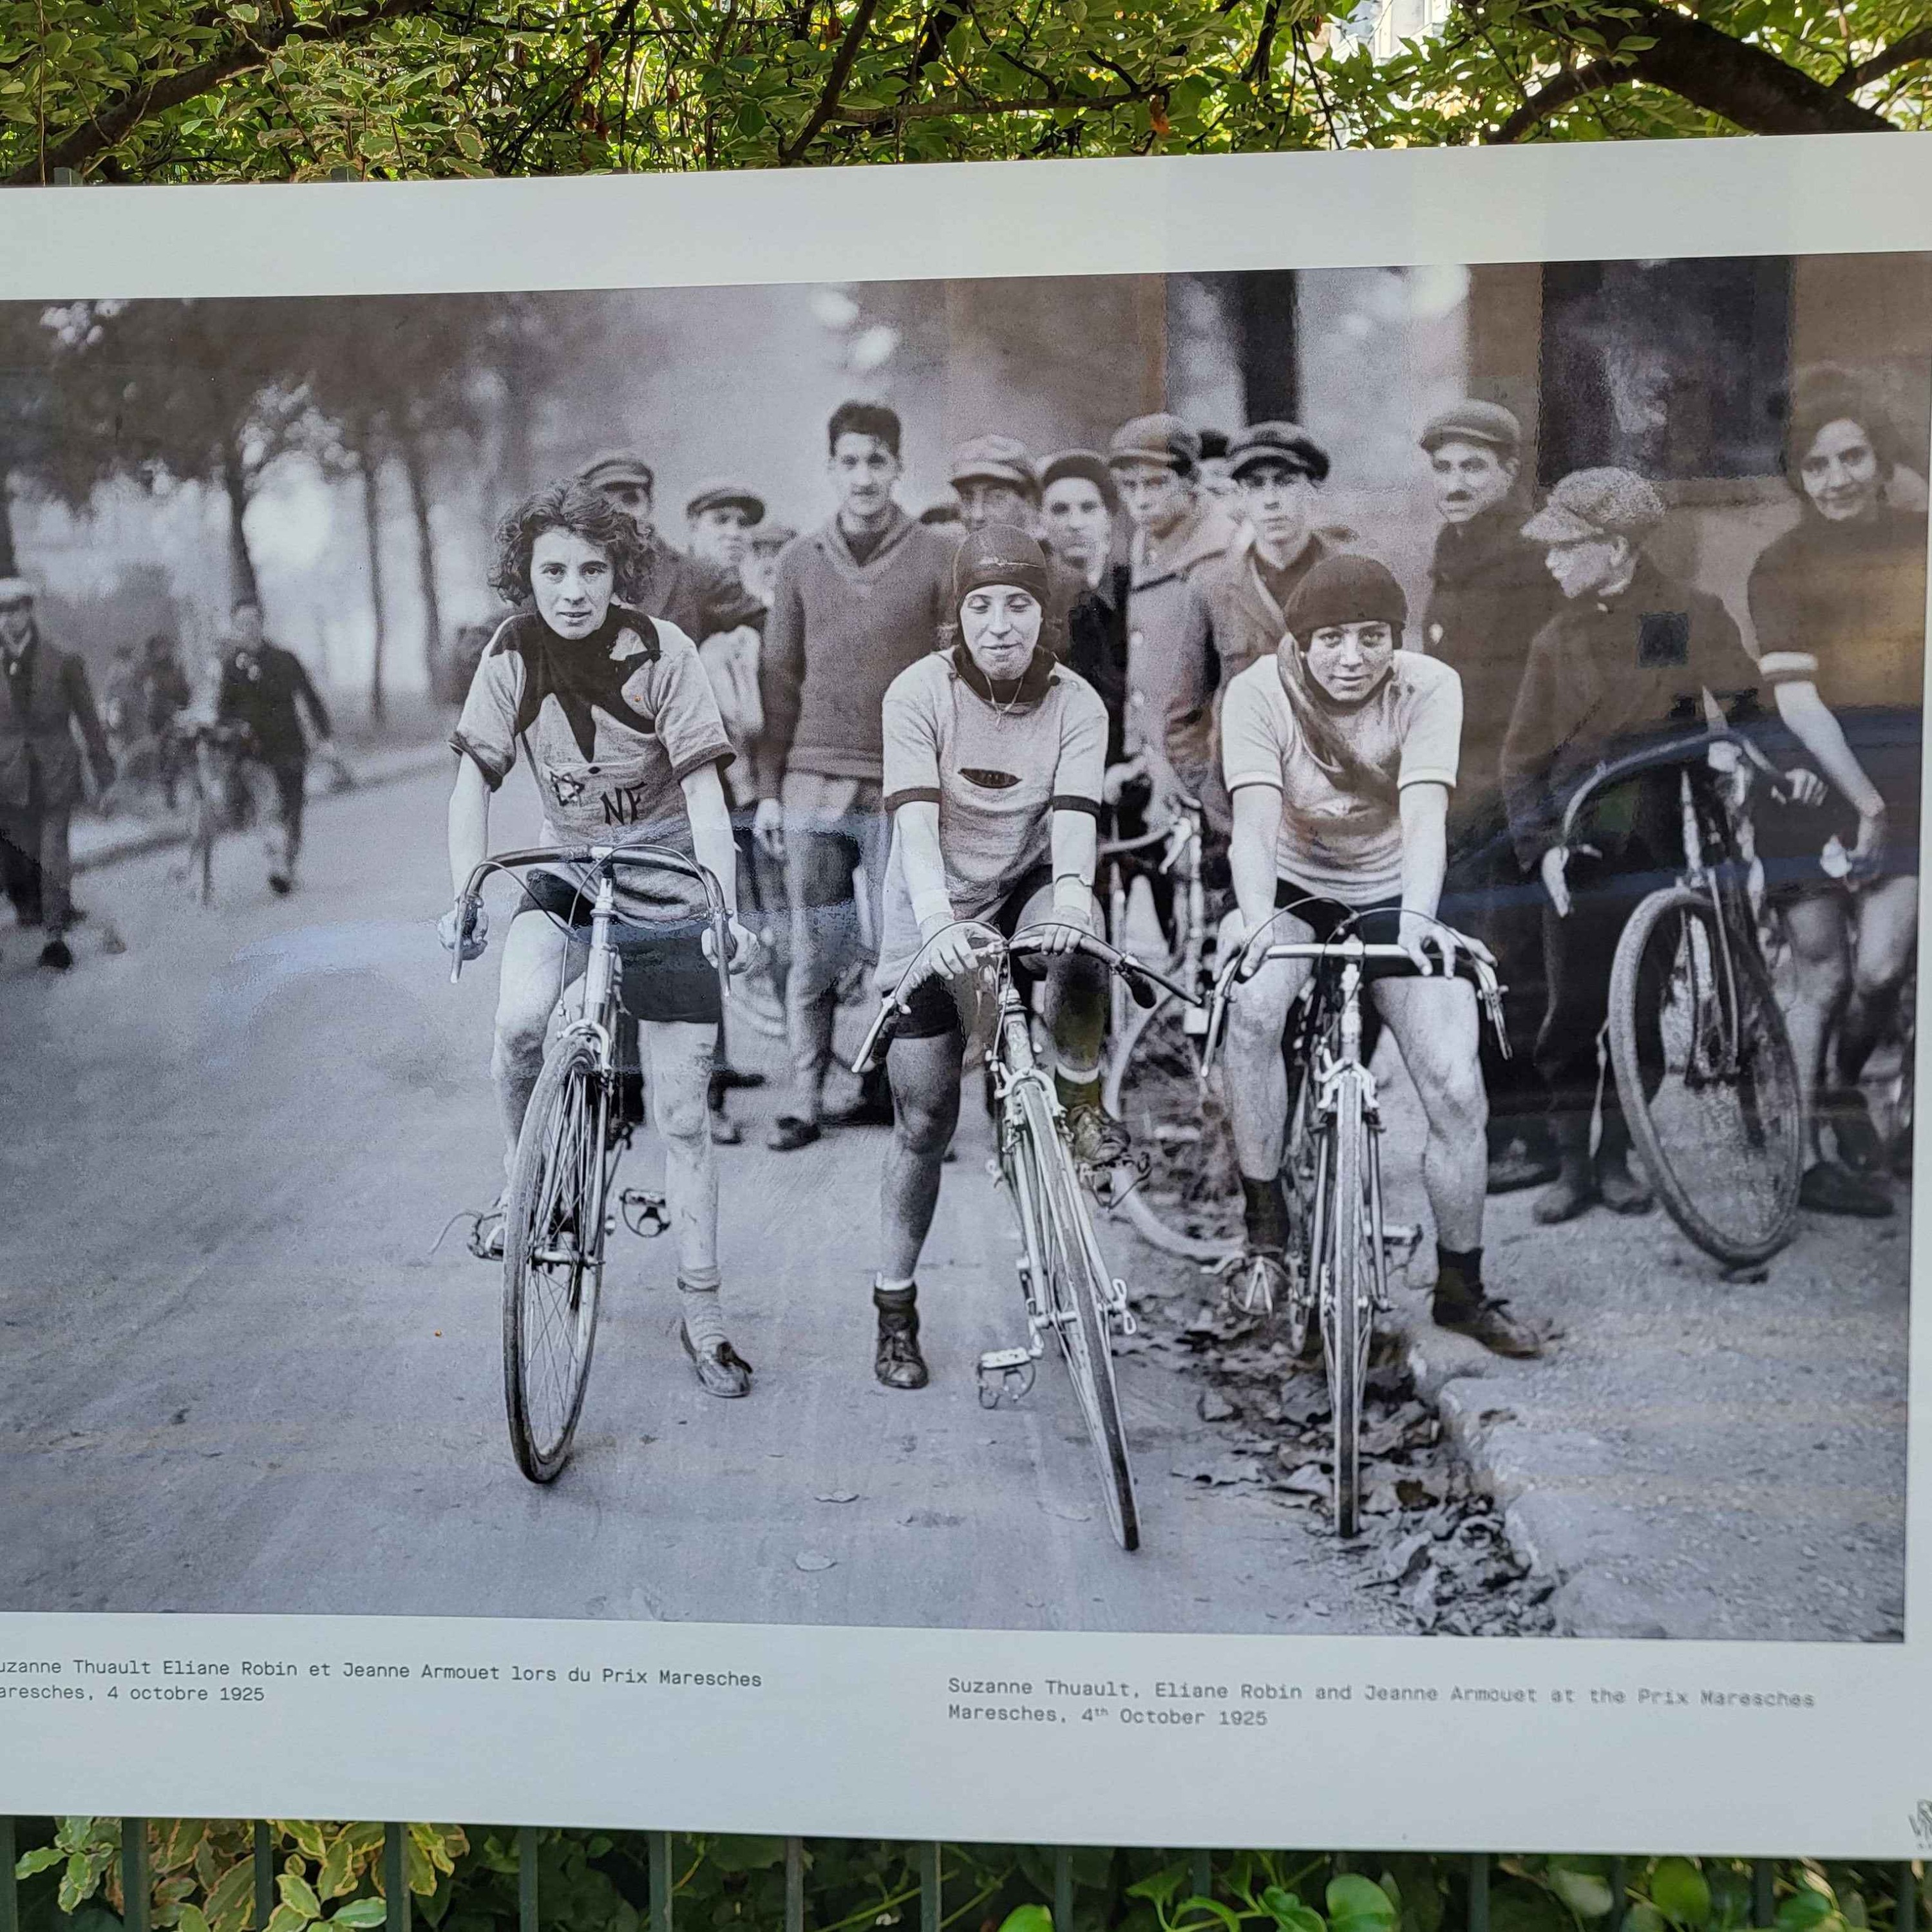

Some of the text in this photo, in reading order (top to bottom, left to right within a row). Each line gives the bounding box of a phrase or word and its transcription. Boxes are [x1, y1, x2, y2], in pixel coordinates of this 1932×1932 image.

[73, 1659, 151, 1674] Thuault
[163, 1660, 230, 1676] Eliane
[242, 1661, 298, 1676] Robin
[308, 1663, 331, 1677] et
[342, 1662, 410, 1678] Jeanne
[421, 1664, 500, 1680] Armouet
[511, 1666, 557, 1681] lors
[568, 1667, 591, 1682] du
[602, 1668, 648, 1684] Prix
[659, 1669, 762, 1687] Maresches
[107, 1686, 119, 1700] 4
[130, 1685, 209, 1701] octobre
[220, 1687, 265, 1701] 1925
[948, 1677, 1815, 1709] Suzanne Thuault, Eliane Robin and Jeanne Armouet at the Prix Maresches
[948, 1703, 1268, 1727] Maresches, 4th October 1925
